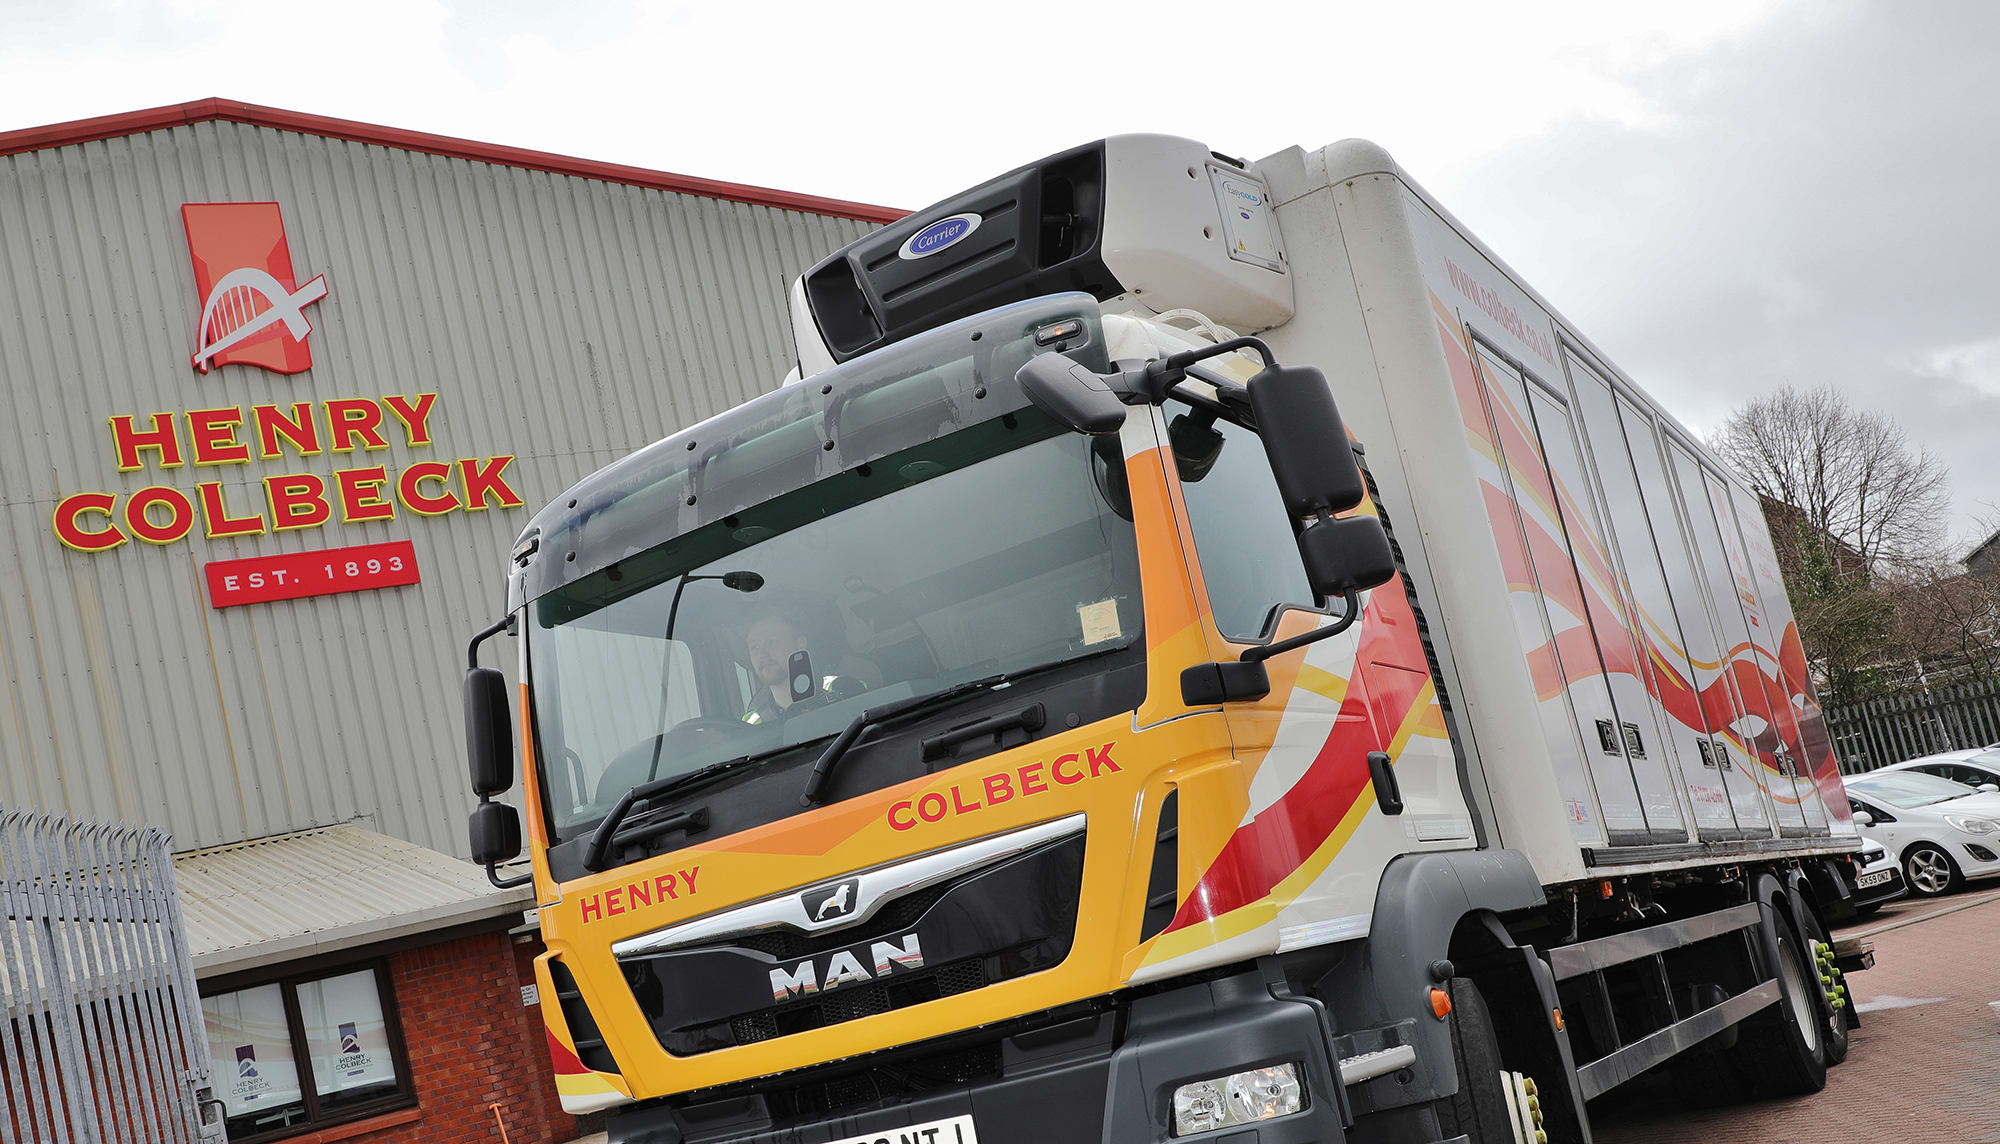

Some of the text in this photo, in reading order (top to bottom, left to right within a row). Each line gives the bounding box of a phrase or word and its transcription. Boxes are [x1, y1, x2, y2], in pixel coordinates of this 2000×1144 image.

[918, 224, 961, 249] Carrier
[109, 393, 437, 472] HENRY
[53, 456, 523, 553] COLBECK
[224, 556, 404, 592] EST. 1893
[887, 741, 1122, 832] COLBECK
[579, 866, 701, 924] HENRY
[1860, 874, 1877, 887] SK59
[768, 932, 925, 1004] MAN
[335, 1058, 372, 1070] COLBECK
[340, 1053, 366, 1064] HENRY
[231, 1081, 271, 1095] COLBECK
[236, 1077, 263, 1088] HENRY
